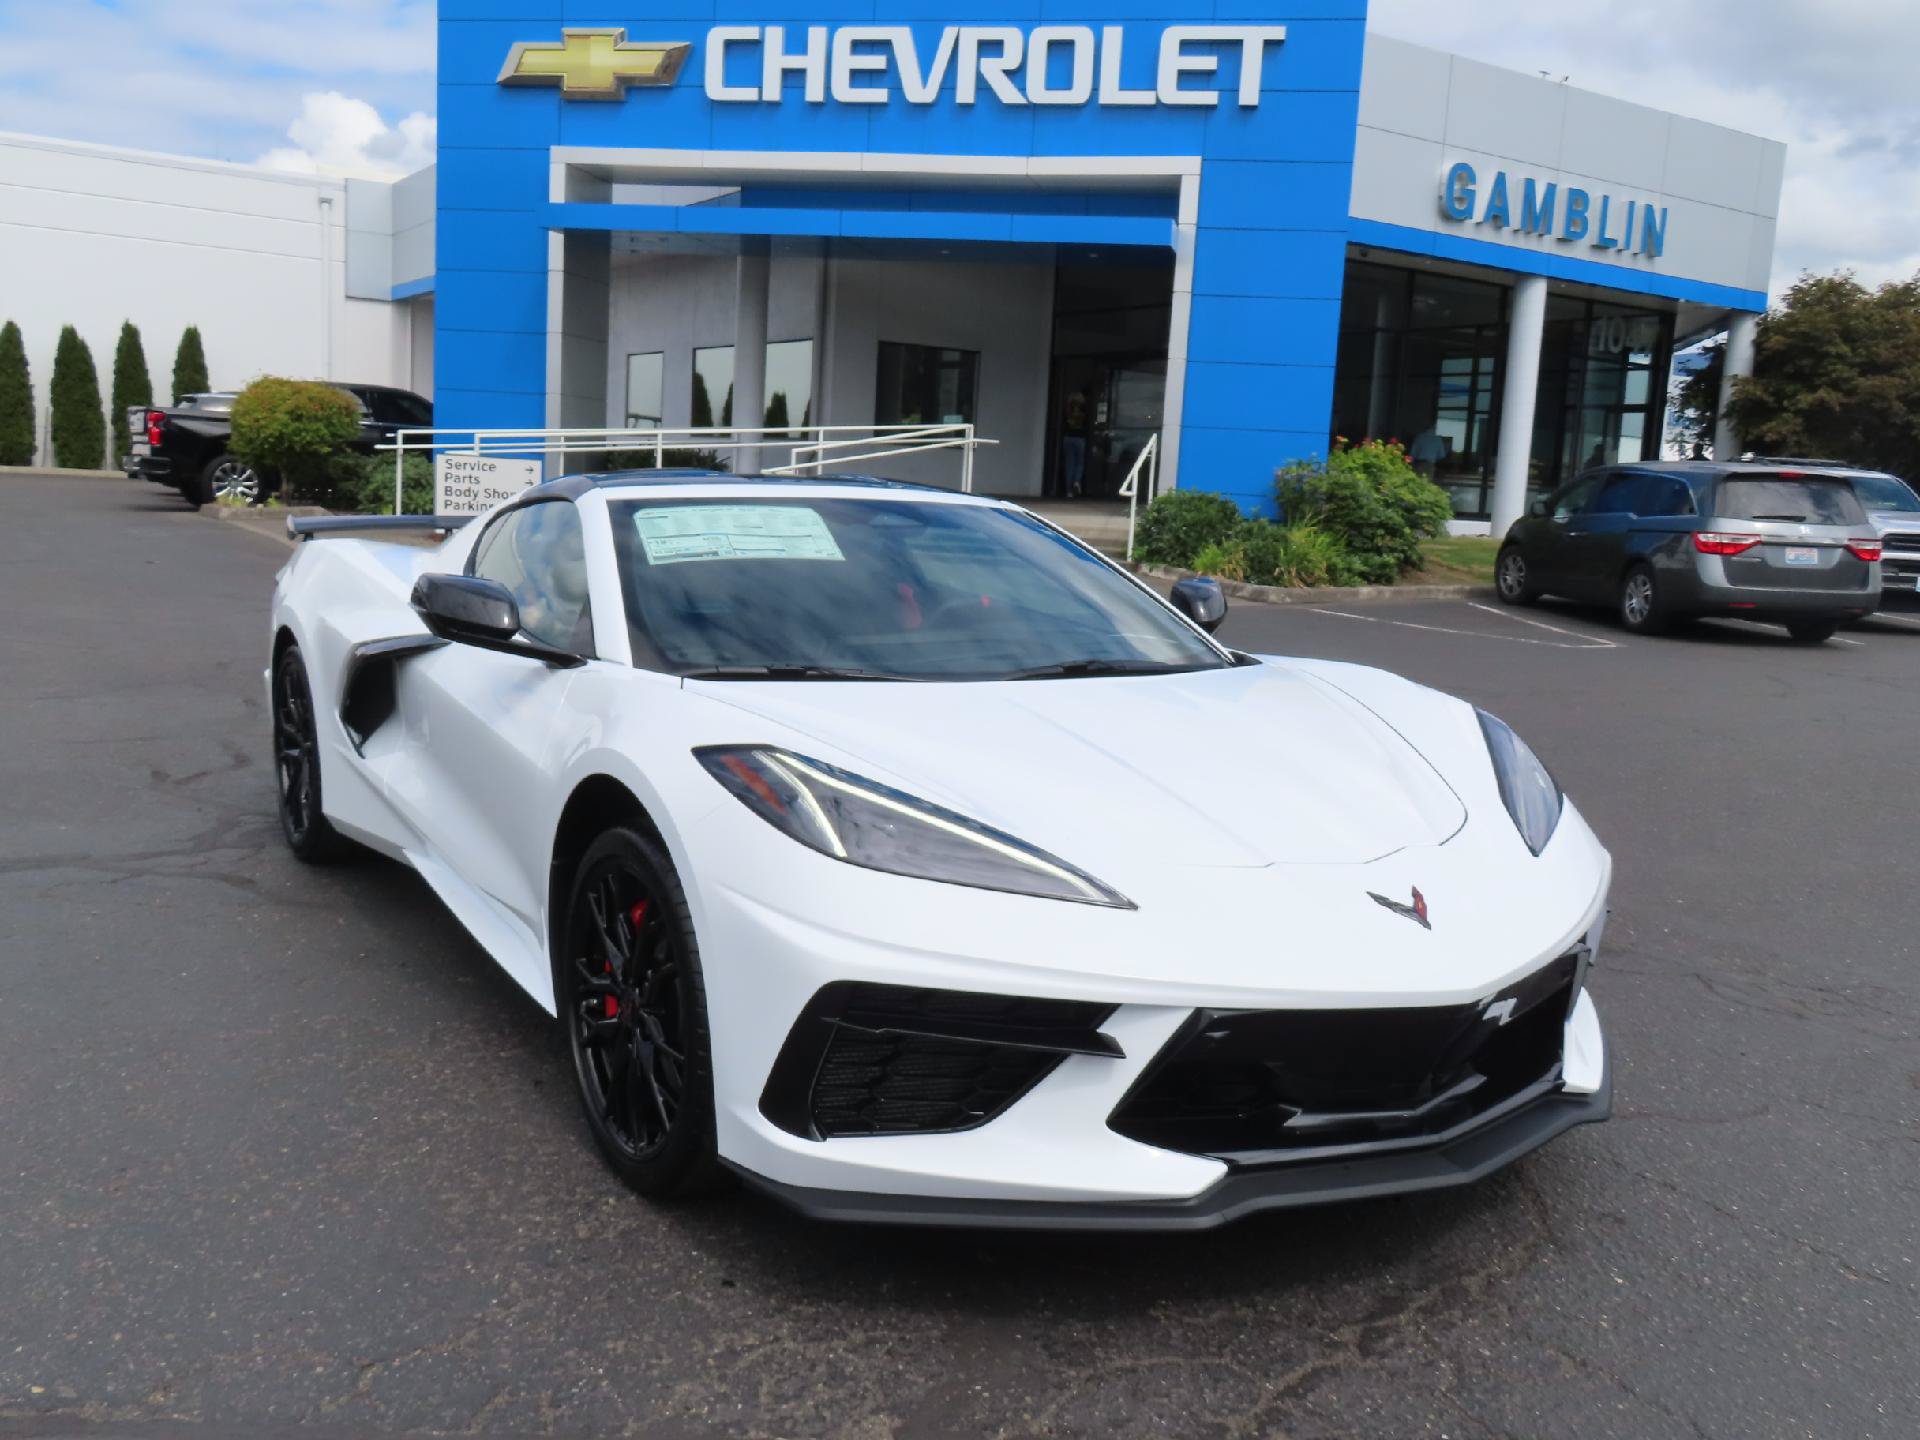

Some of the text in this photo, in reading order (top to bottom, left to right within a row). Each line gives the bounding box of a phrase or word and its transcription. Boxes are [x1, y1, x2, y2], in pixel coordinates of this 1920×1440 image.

[704, 25, 1287, 106] CHEVROLET
[1443, 162, 1668, 258] GAMBLIN
[445, 458, 497, 472] Service
[444, 472, 481, 485] Parts
[444, 485, 480, 501] Body
